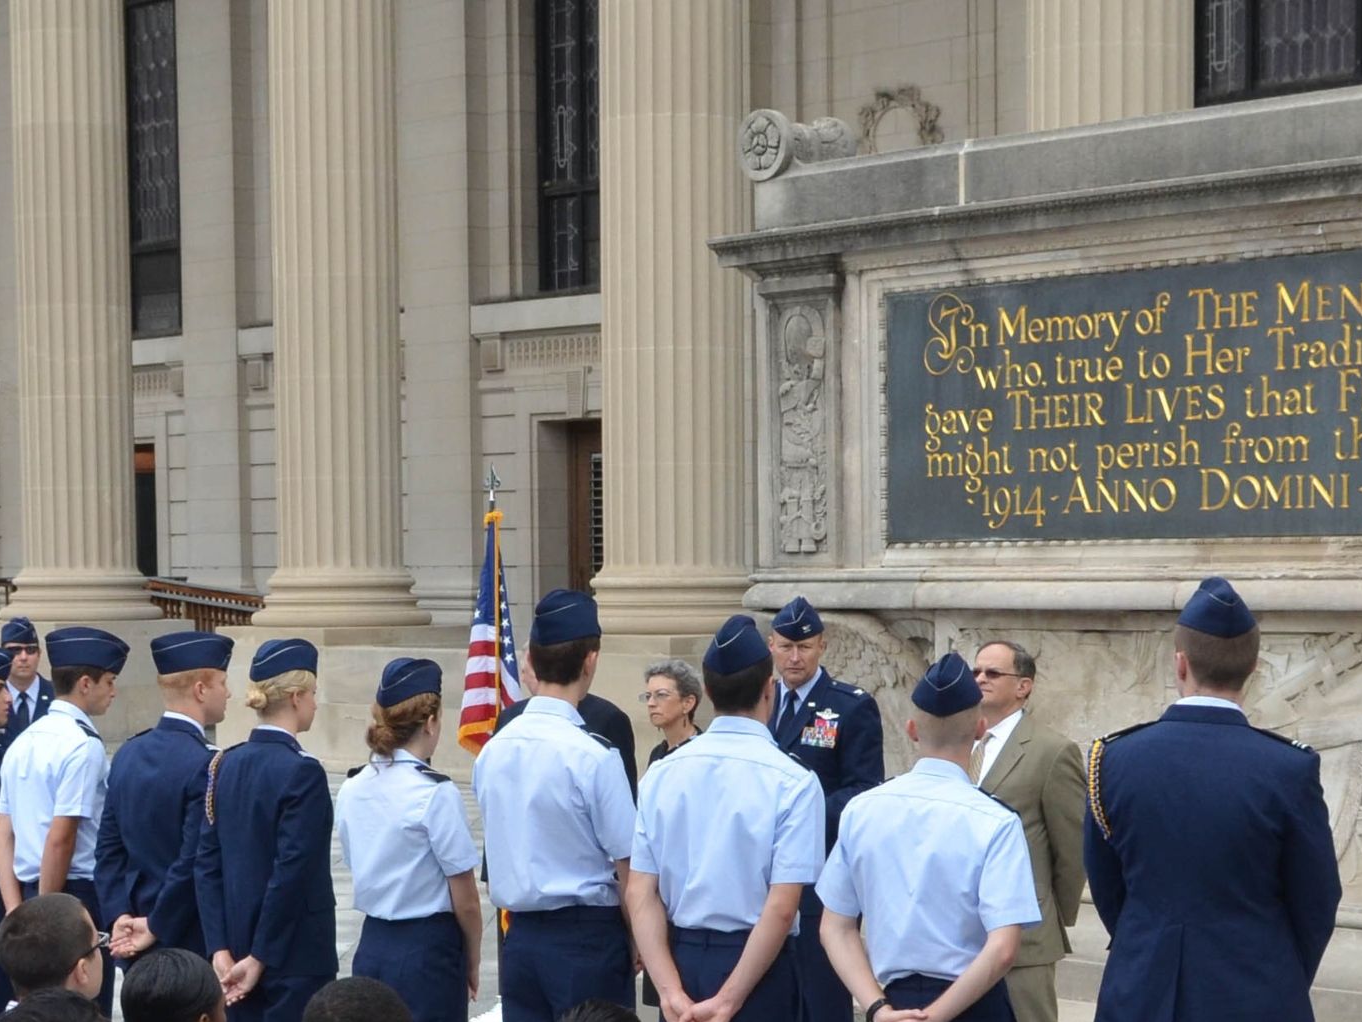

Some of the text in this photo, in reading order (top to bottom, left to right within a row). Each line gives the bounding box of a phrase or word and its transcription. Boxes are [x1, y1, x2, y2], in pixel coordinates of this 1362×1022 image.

[924, 293, 988, 375] In
[997, 305, 1129, 352] Memory
[1135, 292, 1171, 335] of
[1188, 288, 1259, 330] THE
[1056, 352, 1123, 384] true
[1137, 346, 1171, 380] to
[1184, 333, 1250, 376] Her
[925, 402, 993, 452] gave
[1006, 390, 1107, 430] THEIR
[1124, 383, 1226, 424] LIVES
[1245, 375, 1317, 418] that
[927, 436, 1014, 493] might
[1029, 439, 1081, 472] not
[1096, 425, 1200, 480] perish
[1222, 421, 1310, 464] from
